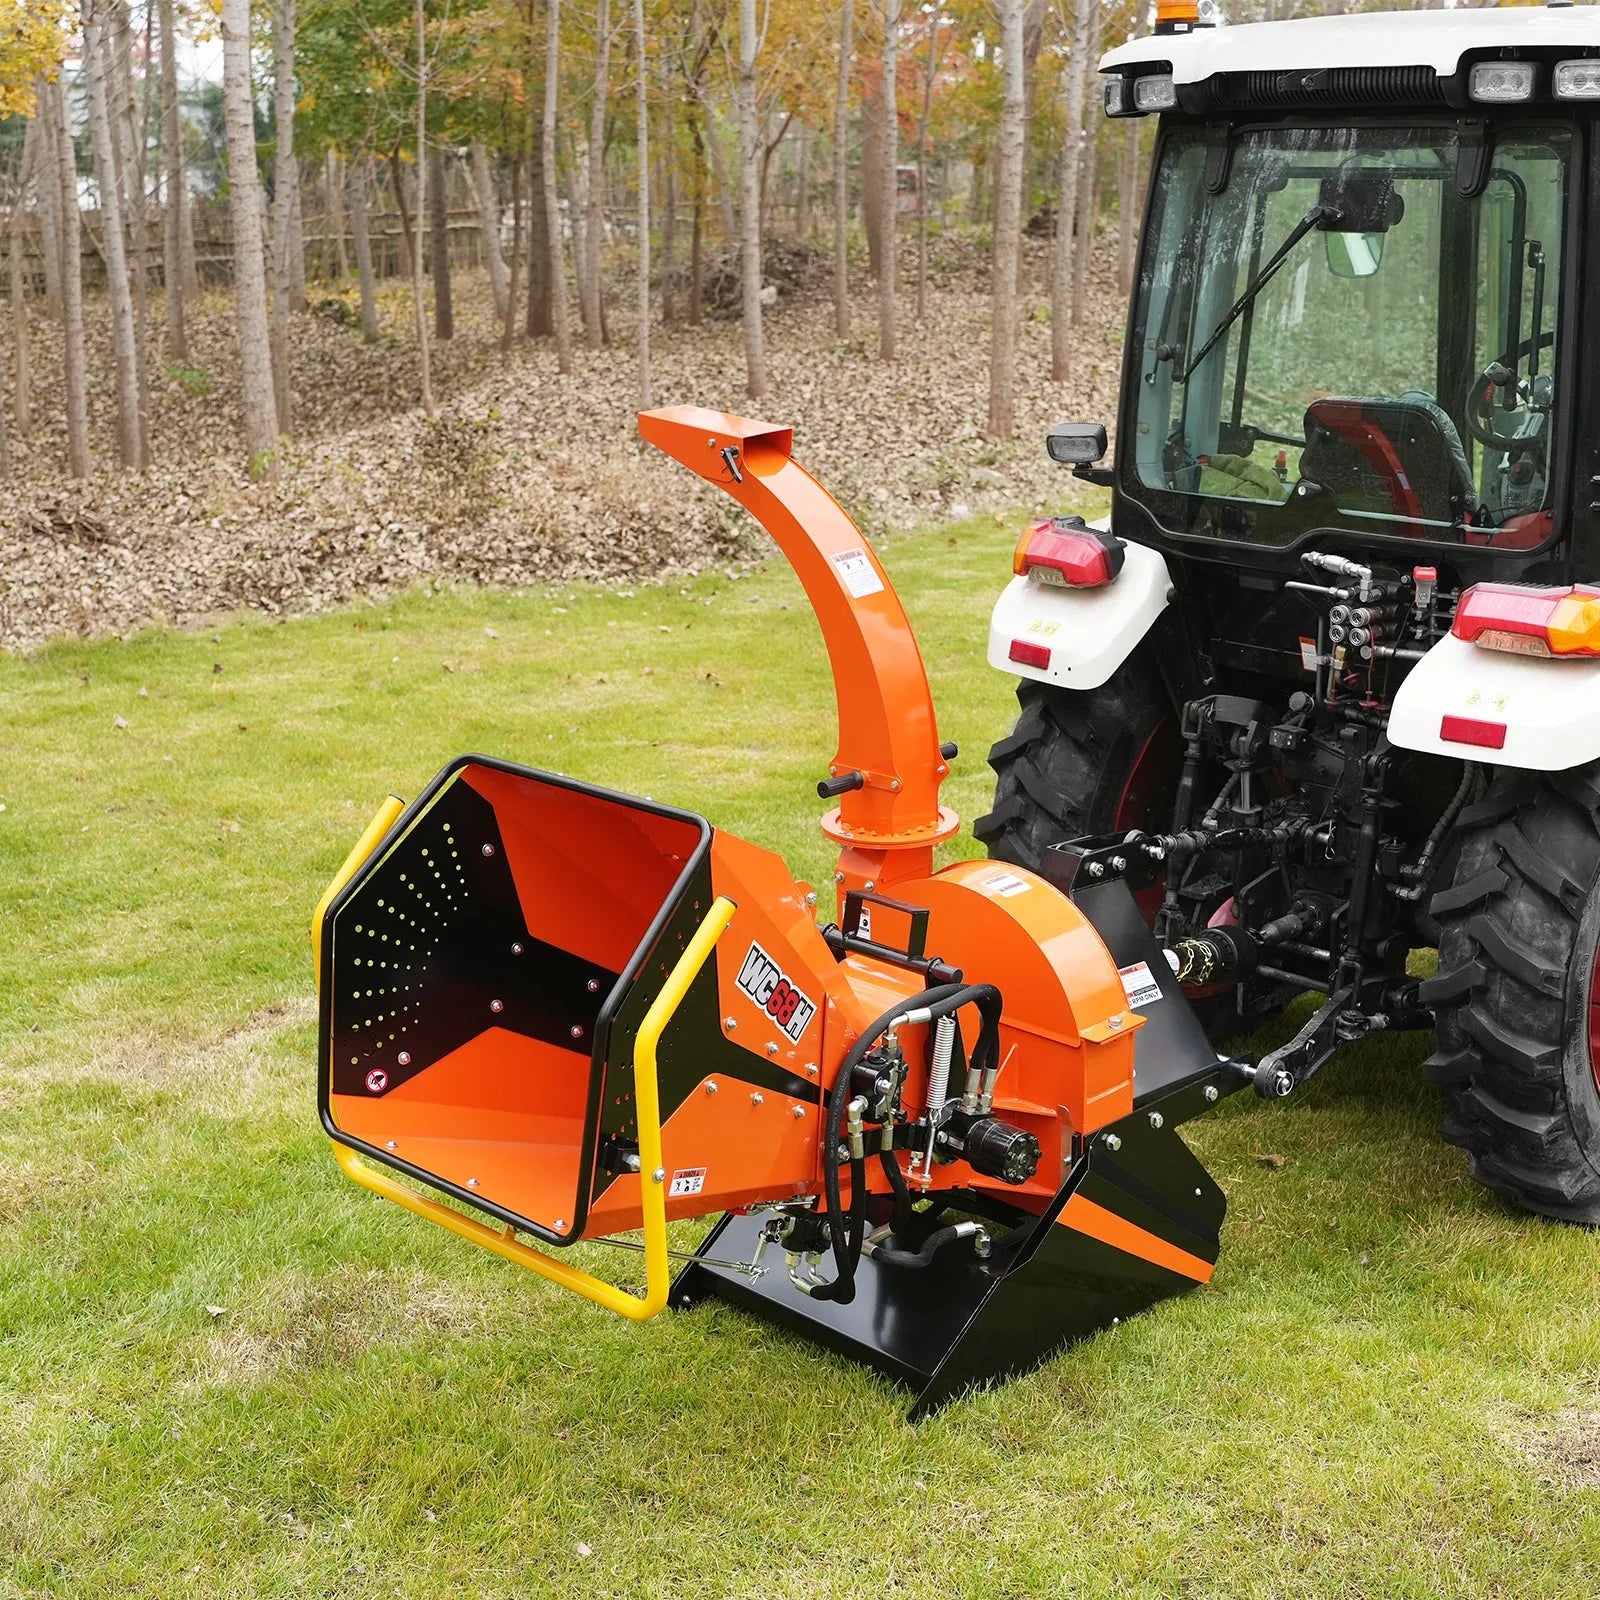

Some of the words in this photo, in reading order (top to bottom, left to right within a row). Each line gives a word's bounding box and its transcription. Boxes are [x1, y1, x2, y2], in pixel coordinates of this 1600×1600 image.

[737, 944, 815, 1042] WC68H
[1132, 996, 1145, 1005] RPM
[1145, 991, 1159, 1000] ONLY
